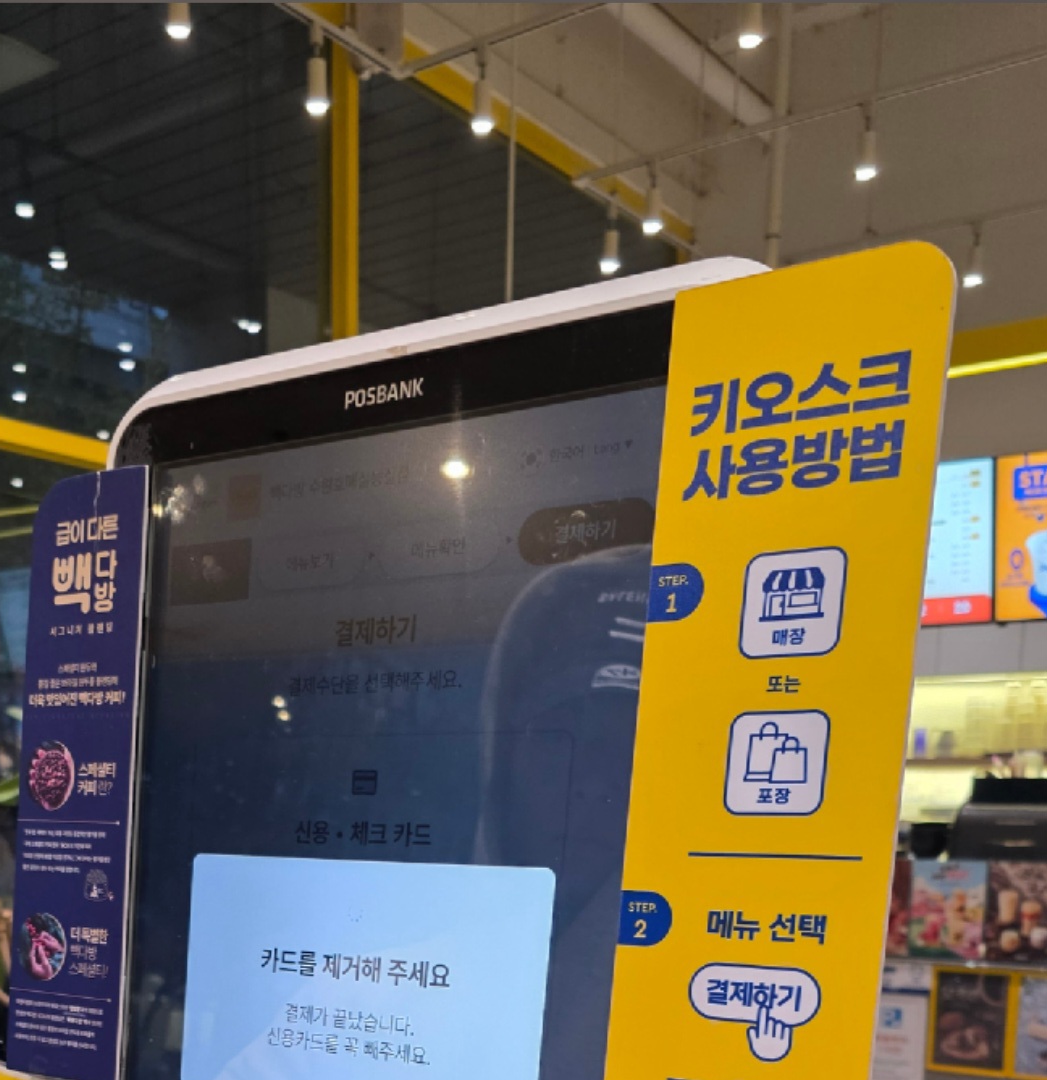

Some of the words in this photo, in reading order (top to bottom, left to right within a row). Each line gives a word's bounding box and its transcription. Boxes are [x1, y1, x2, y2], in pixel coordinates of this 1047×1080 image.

[345, 378, 423, 410] POSBANK
[690, 350, 912, 436] 키오스크
[682, 420, 905, 501] 사용방법
[56, 520, 84, 546] 급이
[87, 514, 119, 541] 다른
[555, 520, 618, 544] 결제하기
[51, 549, 118, 615] 빽다방
[658, 576, 688, 586] STEP.
[666, 594, 677, 613] 1
[335, 614, 417, 647] 결제하기
[772, 628, 806, 646] 매장
[288, 674, 360, 696] 결제수단을
[364, 669, 462, 692] 선택해주세요.
[766, 676, 801, 693] 또는
[757, 788, 792, 804] 포장
[295, 821, 329, 844] 신용
[351, 823, 387, 846] 체크
[393, 823, 431, 846] 카드
[628, 902, 657, 913] STEP.
[634, 920, 647, 938] 2
[707, 911, 760, 940] 메뉴
[769, 913, 828, 945] 선택
[261, 948, 316, 977] 카드를
[323, 954, 380, 983] 제거해
[388, 960, 450, 988] 주세요
[707, 980, 802, 1012] 결제하기
[285, 1003, 329, 1027] 결제가
[333, 1011, 415, 1038] 끝났습니다.
[267, 1027, 339, 1055] 신용카드를
[345, 1037, 359, 1056] 꼭
[364, 1040, 430, 1066] 빼주세요.
